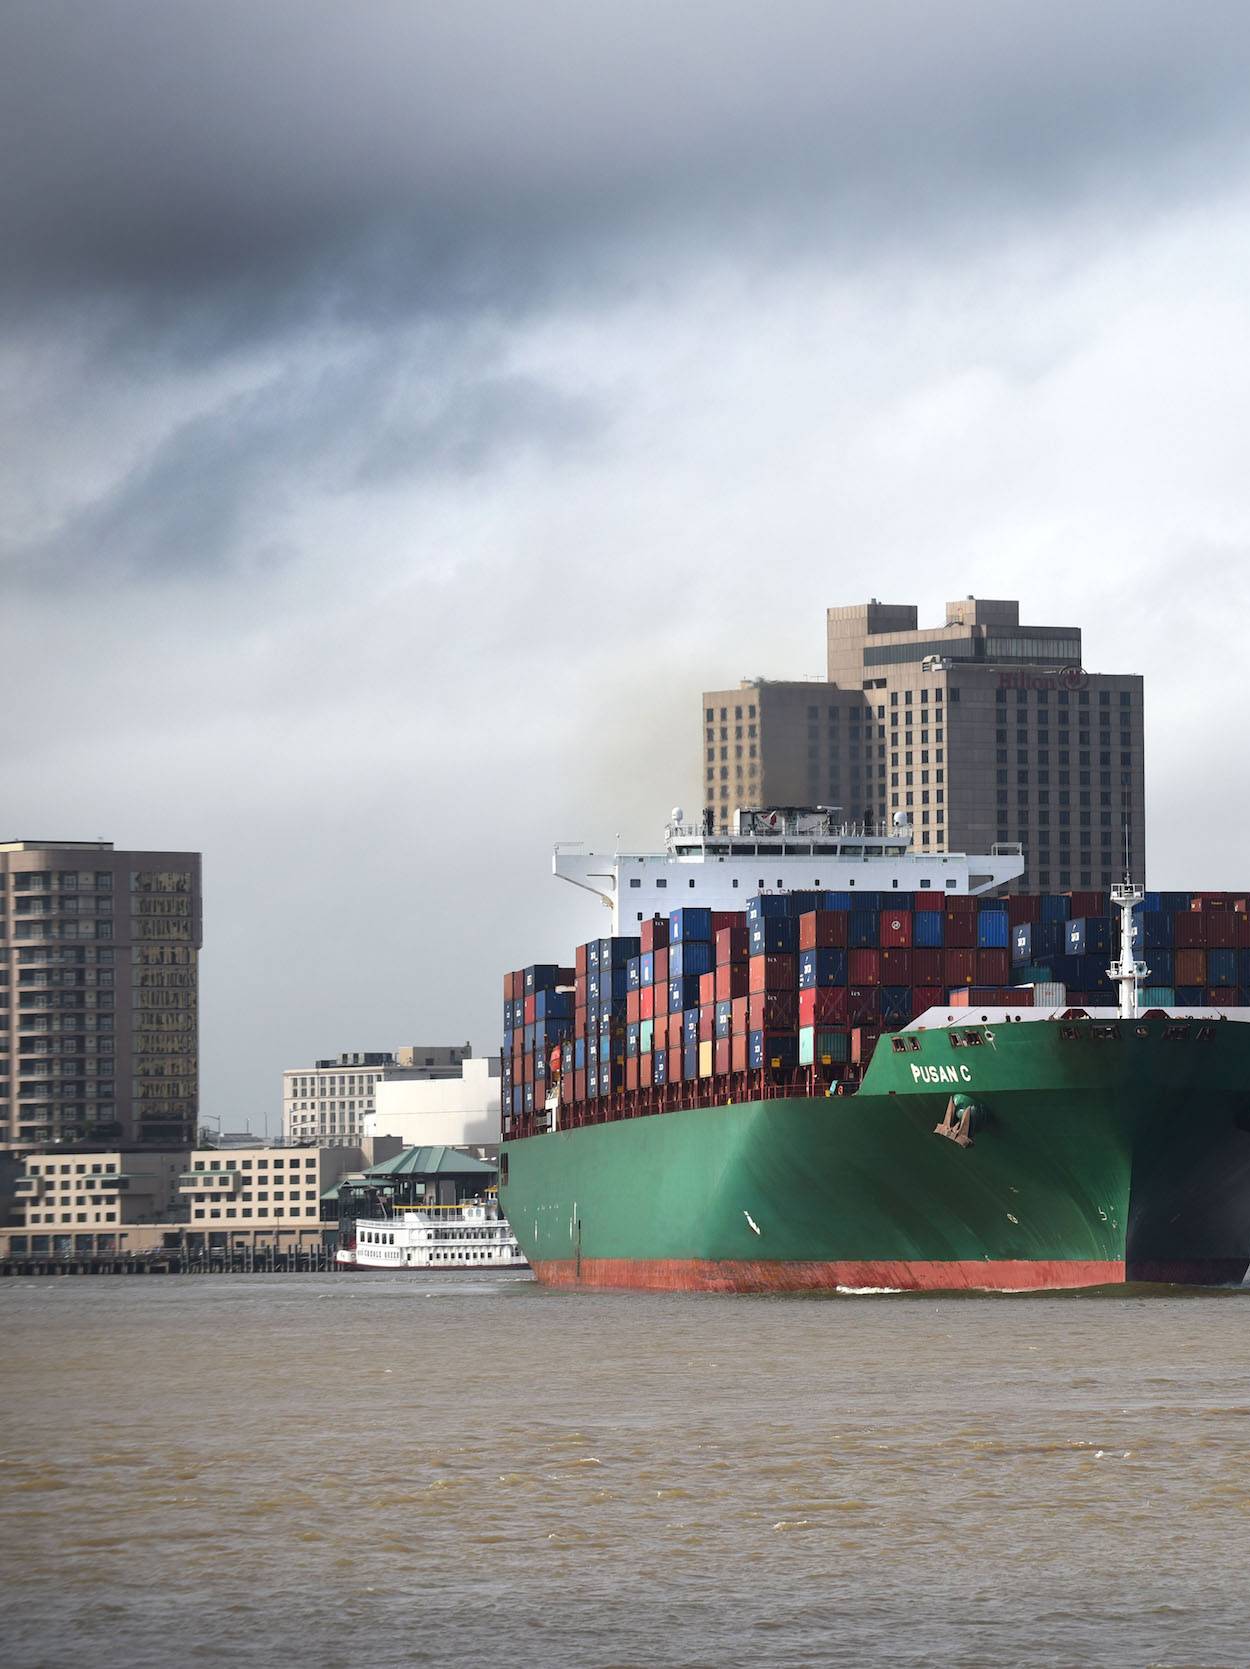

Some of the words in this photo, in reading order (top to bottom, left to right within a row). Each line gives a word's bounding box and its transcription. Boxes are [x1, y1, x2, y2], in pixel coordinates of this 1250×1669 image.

[998, 672, 1057, 690] Hilton
[911, 1063, 959, 1083] PUSAN
[960, 1064, 972, 1082] C
